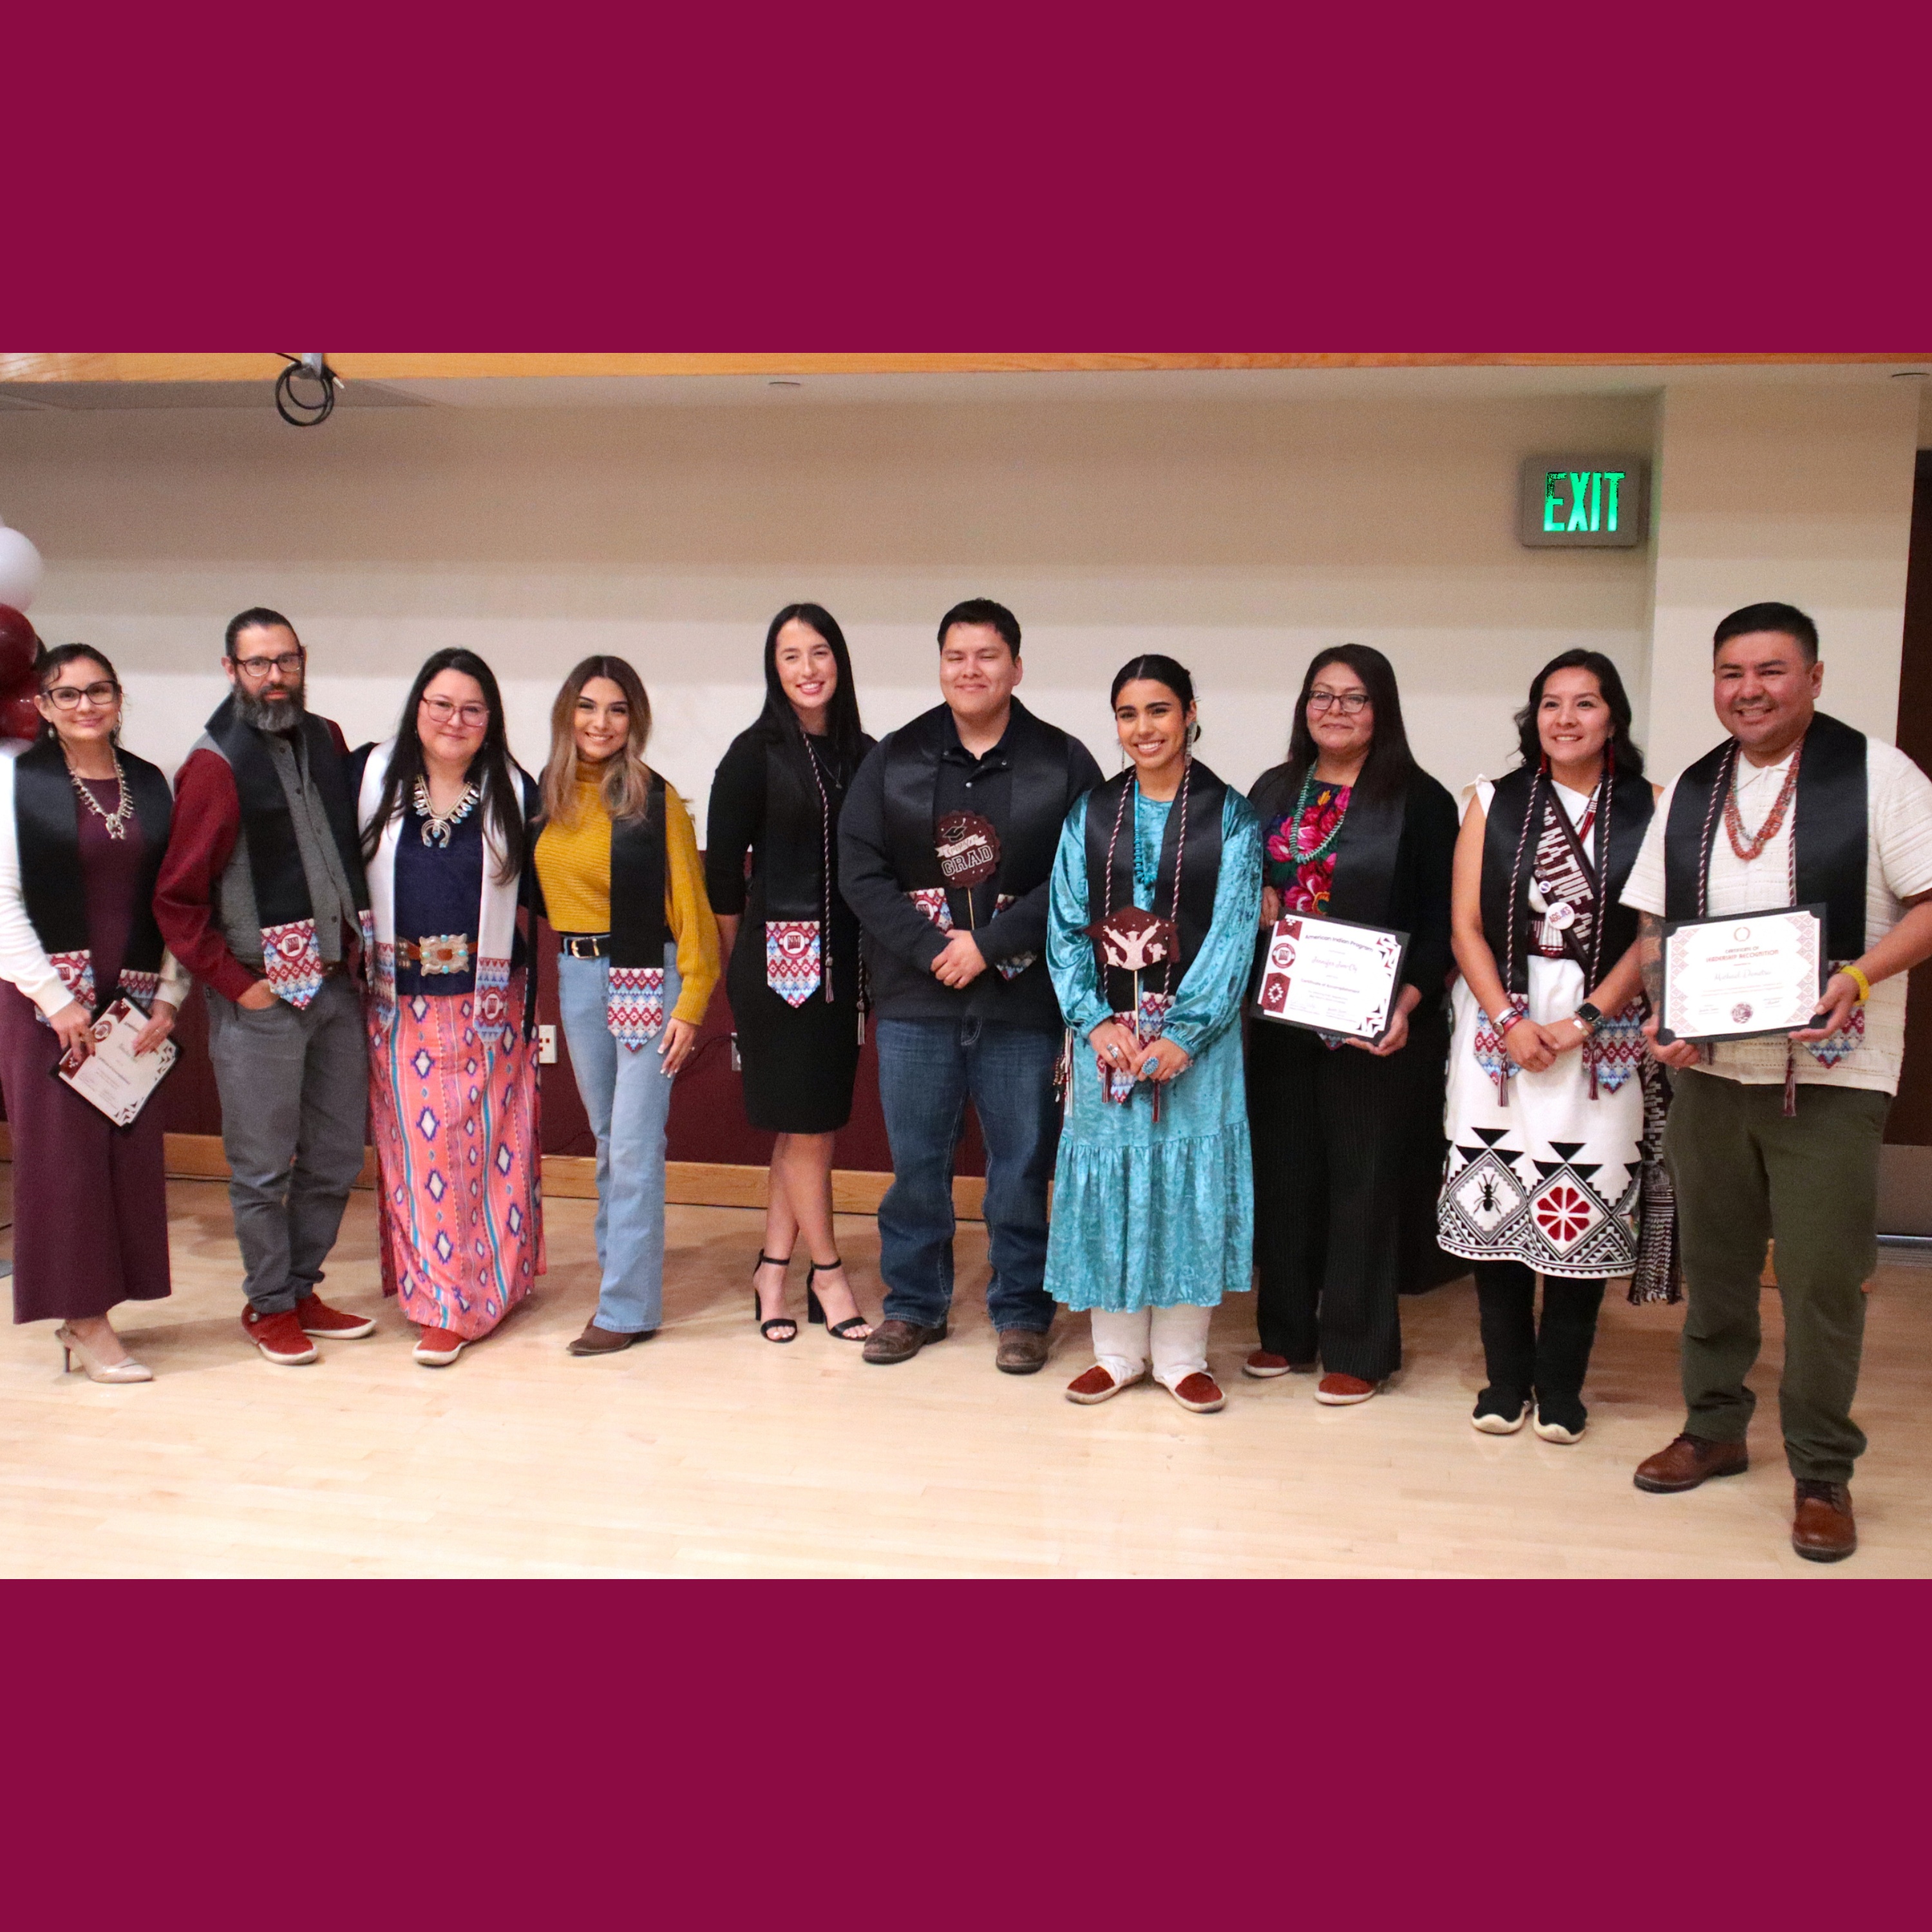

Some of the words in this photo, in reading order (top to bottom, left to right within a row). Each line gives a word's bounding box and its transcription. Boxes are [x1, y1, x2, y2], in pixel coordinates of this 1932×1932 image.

[1543, 471, 1625, 532] EXIT
[942, 845, 993, 876] GRAD
[1350, 940, 1374, 952] Program
[1706, 954, 1738, 963] LEADERSHIP
[1738, 949, 1779, 959] RECOGNITION
